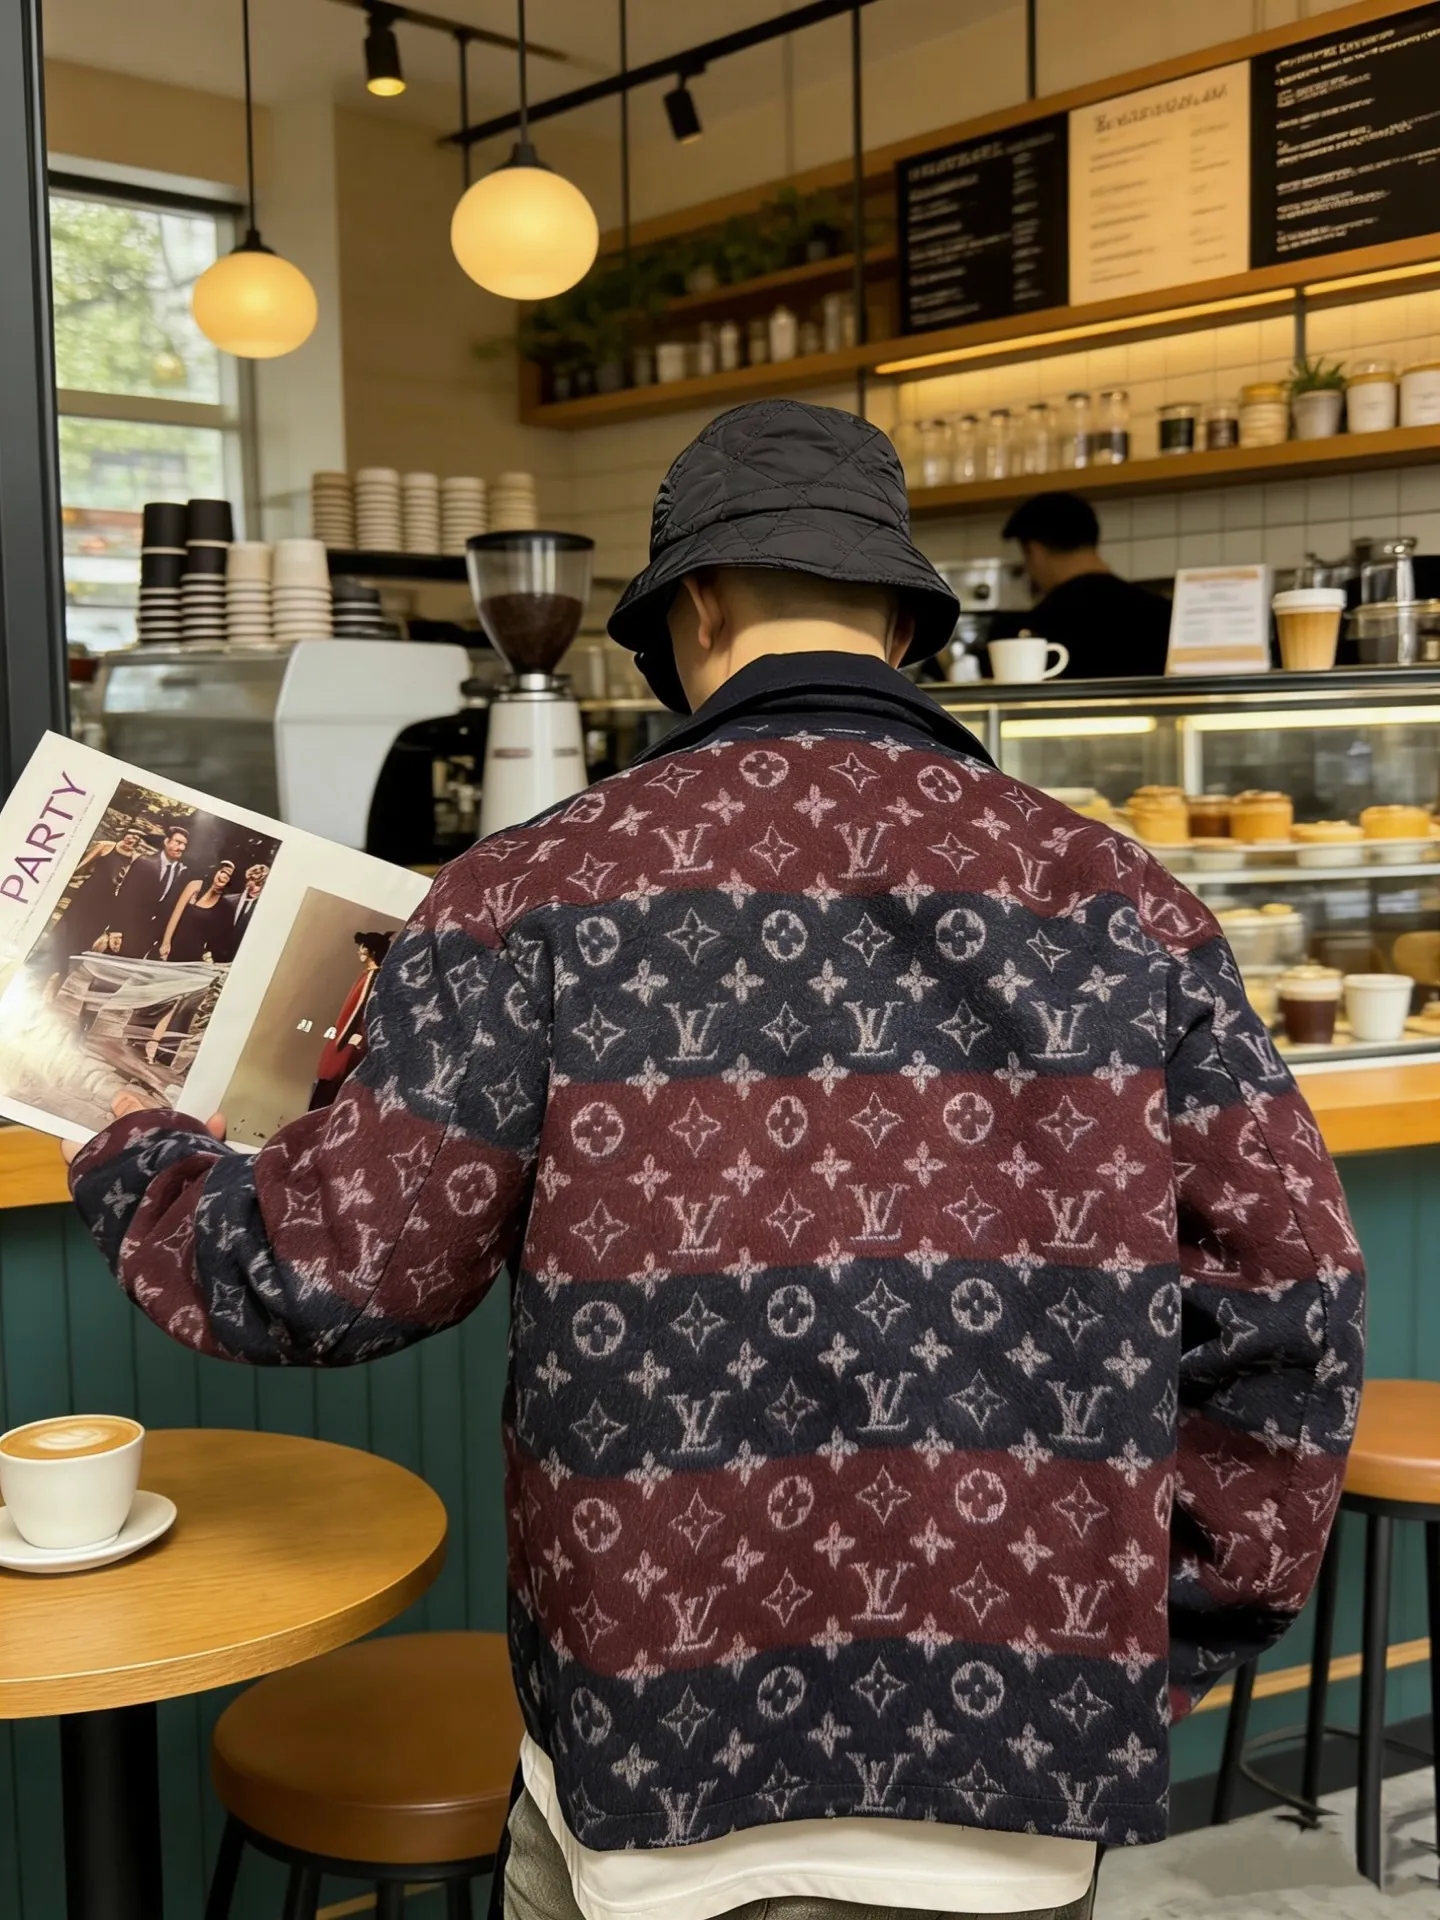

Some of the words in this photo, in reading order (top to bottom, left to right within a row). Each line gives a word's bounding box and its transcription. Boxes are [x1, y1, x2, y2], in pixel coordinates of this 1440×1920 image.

[0, 771, 87, 904] PARTY
[651, 822, 714, 875] LV
[833, 821, 896, 878] LV
[663, 1001, 728, 1061] LV
[843, 1000, 904, 1057] LV
[1029, 1001, 1090, 1060] LV
[664, 1194, 729, 1255] LV
[846, 1182, 910, 1241] LV
[1036, 1188, 1105, 1249] LV
[664, 1390, 730, 1455] LV
[855, 1371, 917, 1432] LV
[1045, 1379, 1112, 1444] LV
[660, 1584, 727, 1653] LV
[848, 1561, 917, 1621] LV
[1047, 1574, 1115, 1639] LV
[845, 1752, 911, 1814] LV
[1048, 1770, 1118, 1835] LV
